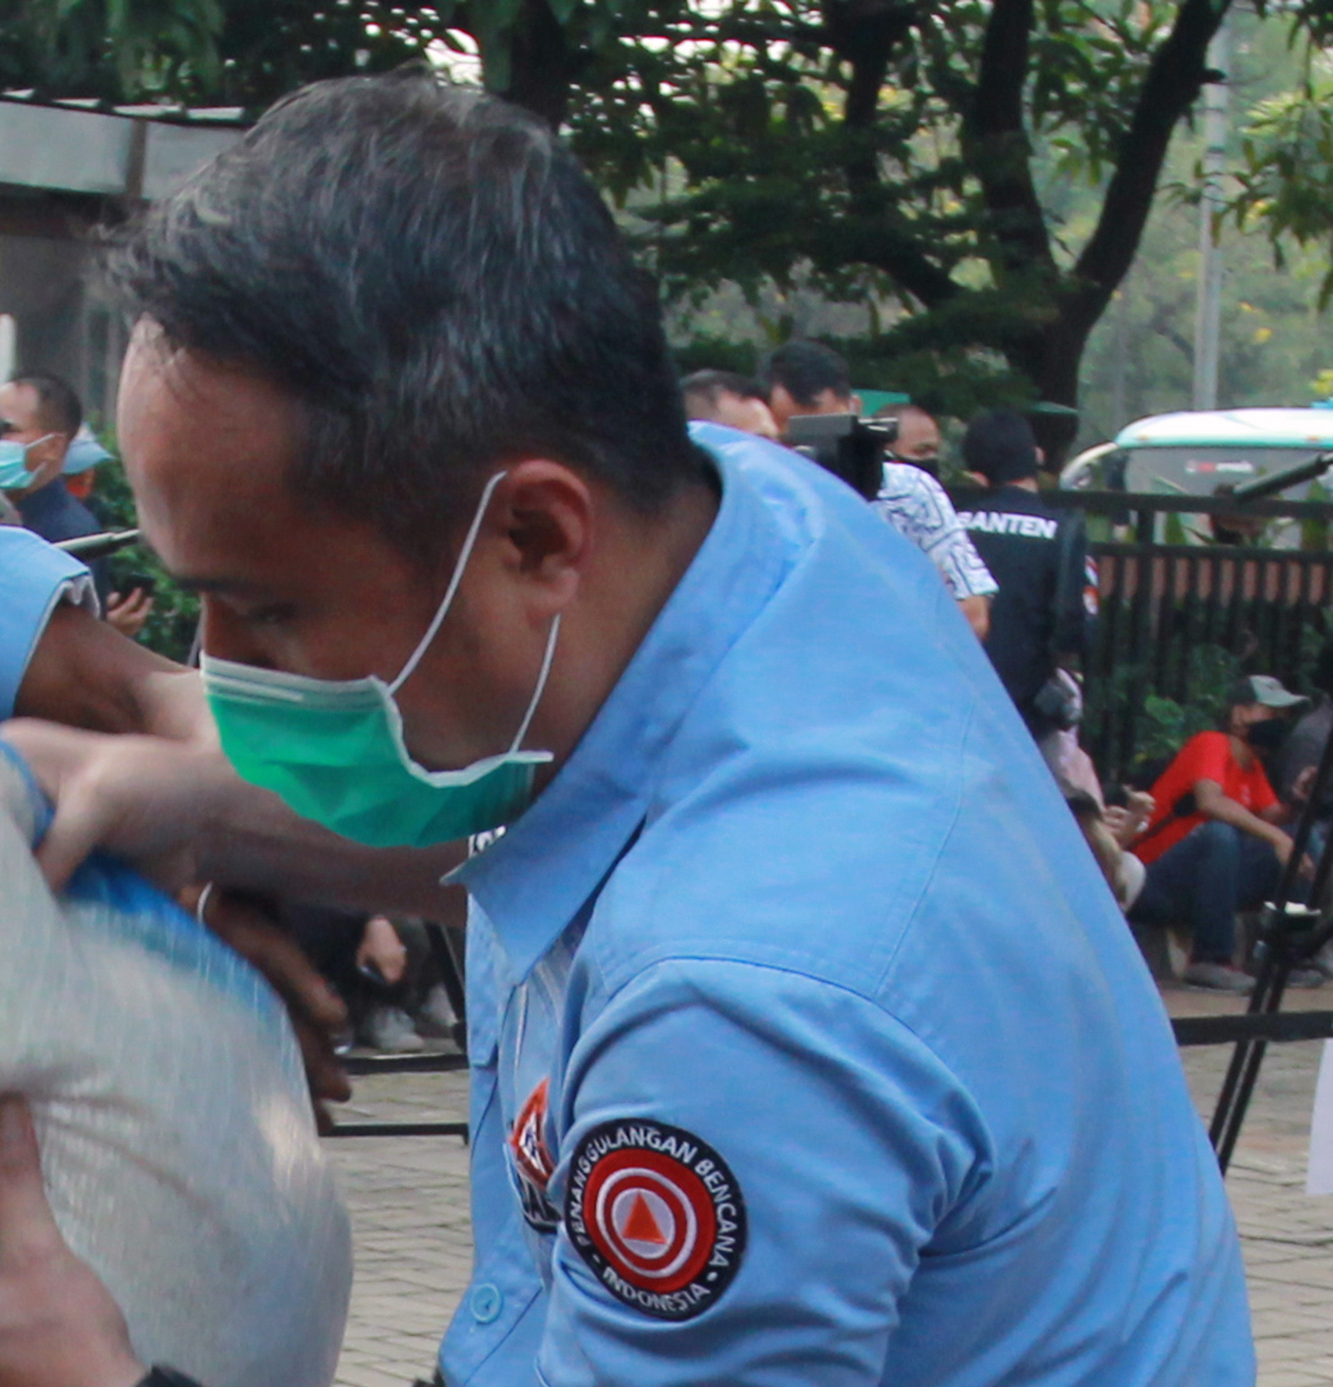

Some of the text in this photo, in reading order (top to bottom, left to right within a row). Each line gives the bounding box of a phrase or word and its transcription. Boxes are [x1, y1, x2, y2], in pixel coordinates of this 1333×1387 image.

[570, 1127, 698, 1247] PENANGGULANGAN
[694, 1159, 737, 1268] BENCANA
[602, 1266, 711, 1312] INDONESIA
